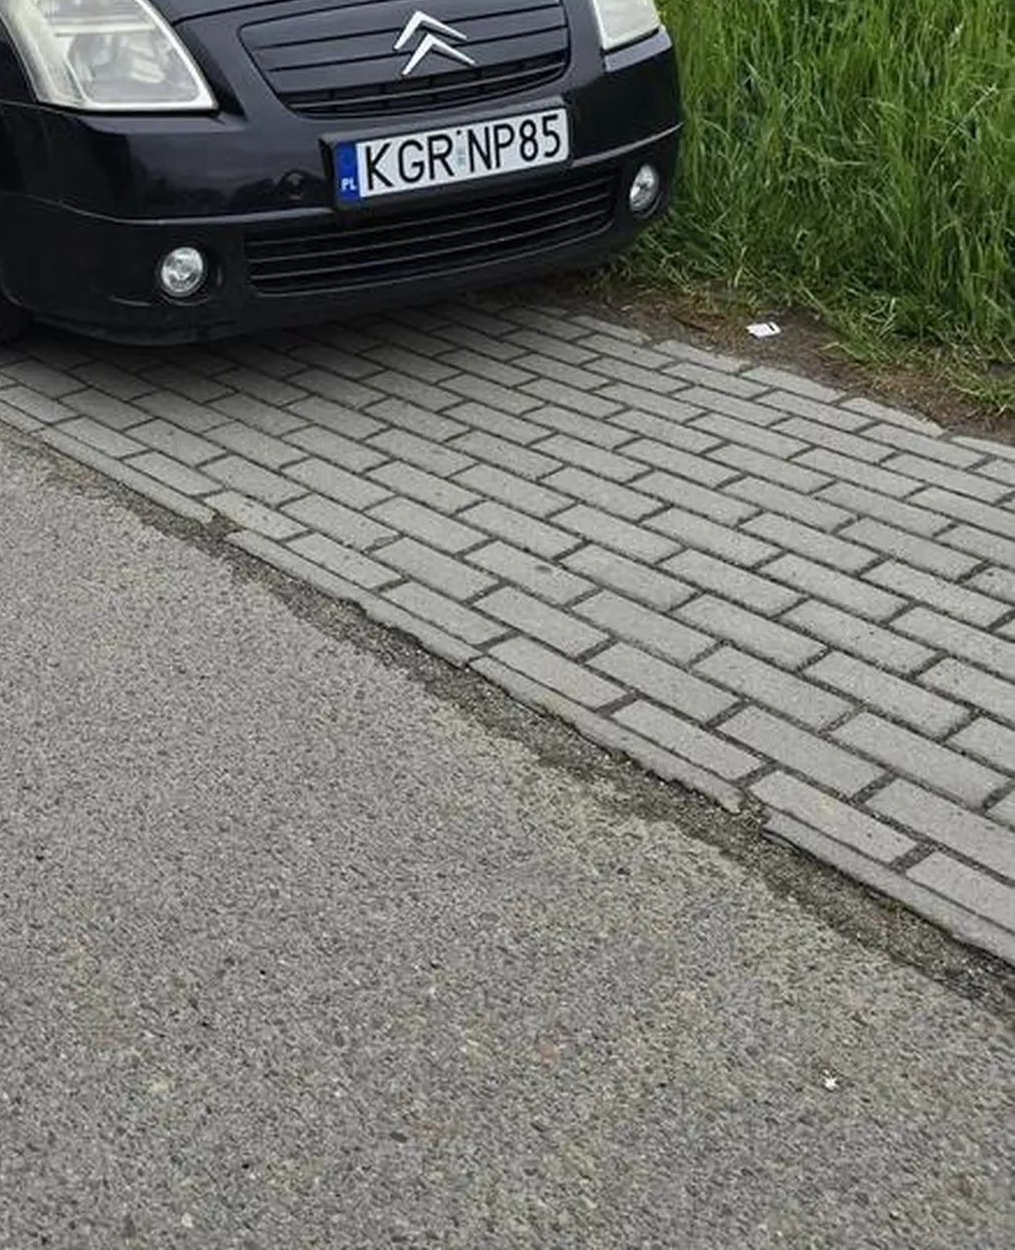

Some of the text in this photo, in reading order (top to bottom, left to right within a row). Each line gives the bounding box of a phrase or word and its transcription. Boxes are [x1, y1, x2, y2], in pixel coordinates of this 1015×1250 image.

[365, 115, 561, 190] KGR NP85
[341, 178, 356, 190] PL
